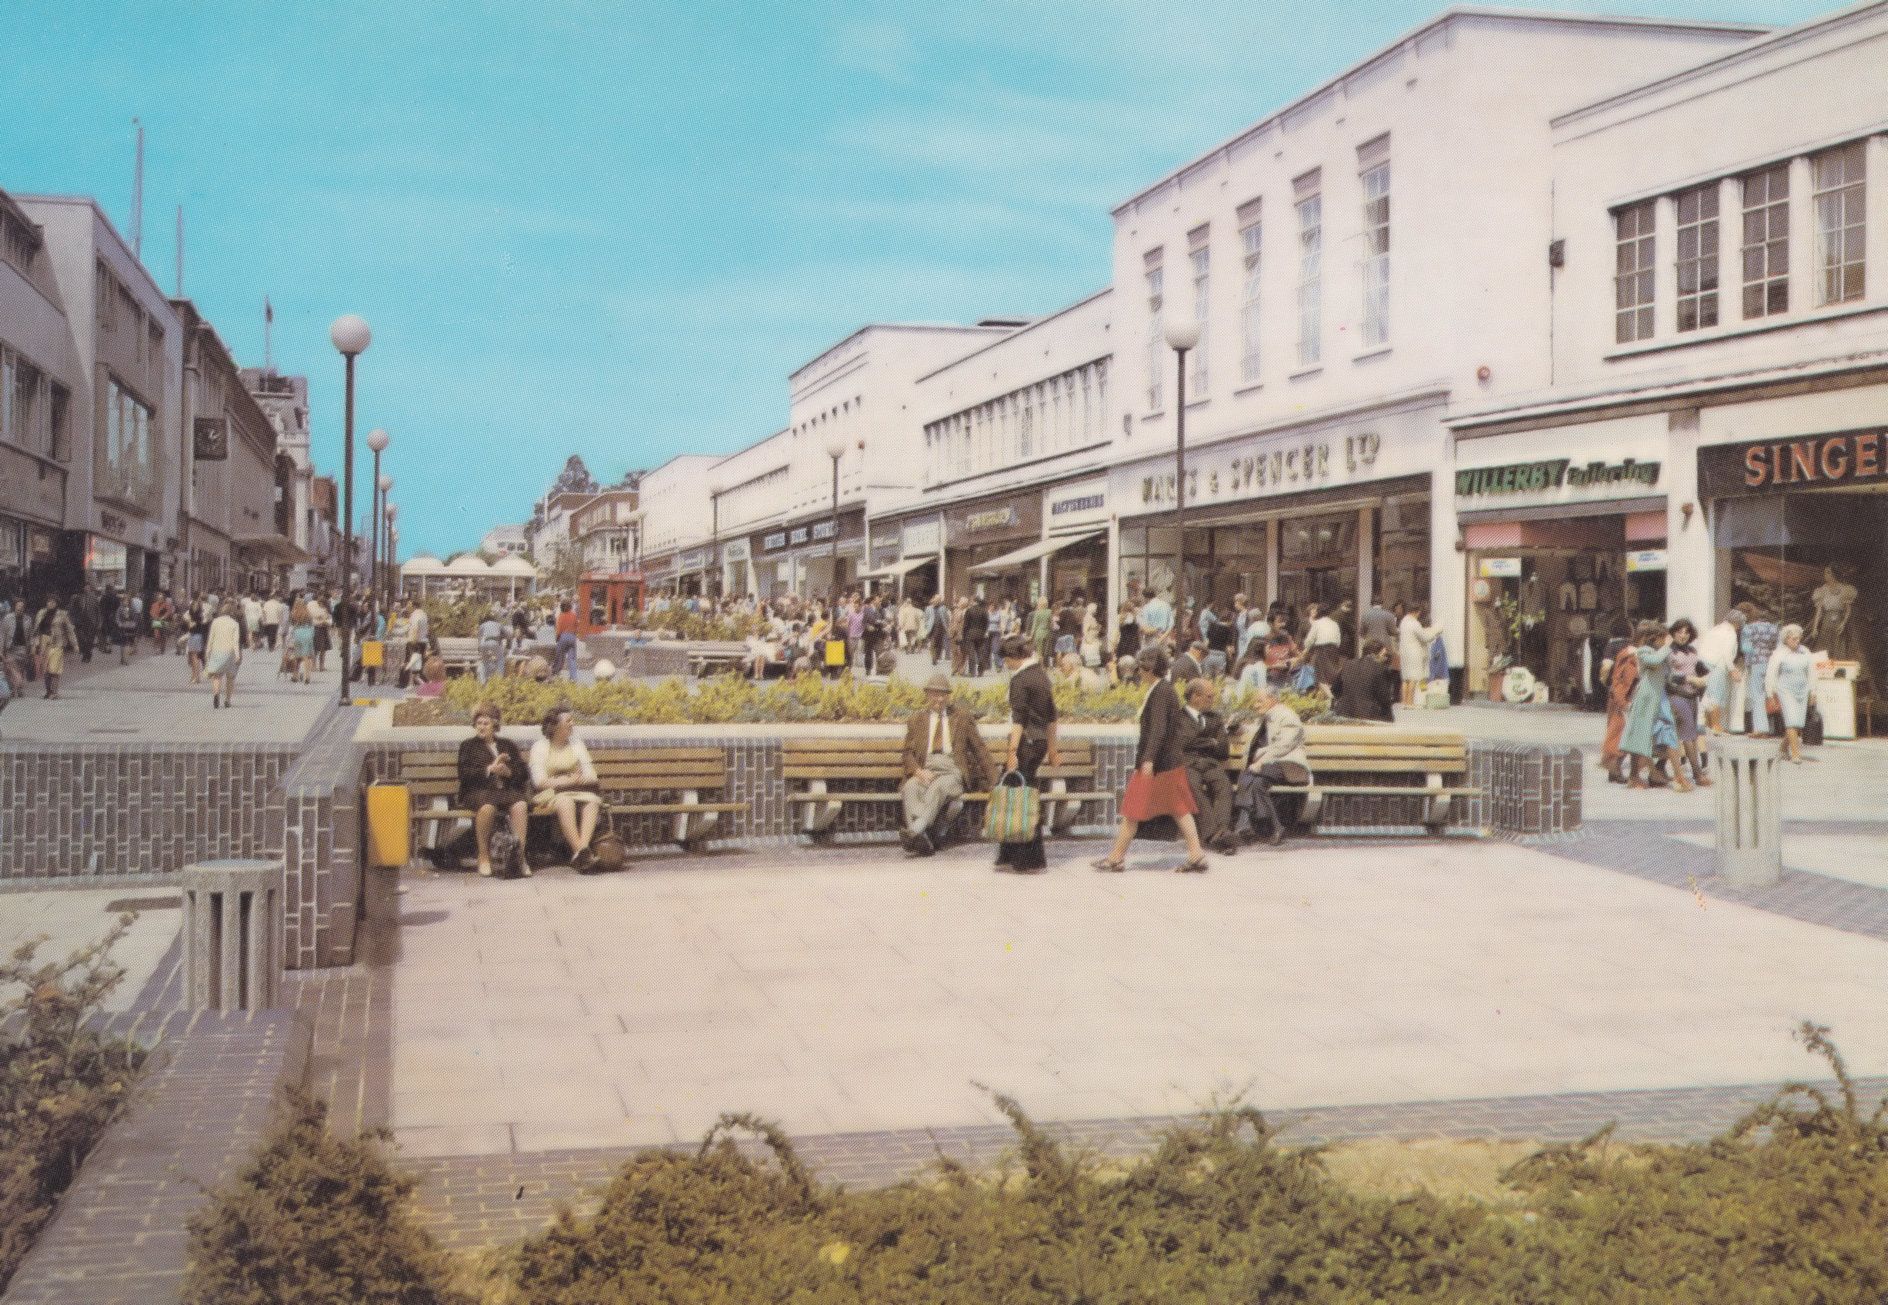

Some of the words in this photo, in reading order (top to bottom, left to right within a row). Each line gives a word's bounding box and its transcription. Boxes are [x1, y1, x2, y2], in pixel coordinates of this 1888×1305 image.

[1142, 468, 1198, 504] MARS
[1229, 443, 1329, 490] SPENCER
[1456, 458, 1570, 495] WILLERBY
[1745, 433, 1888, 487] SINGE
